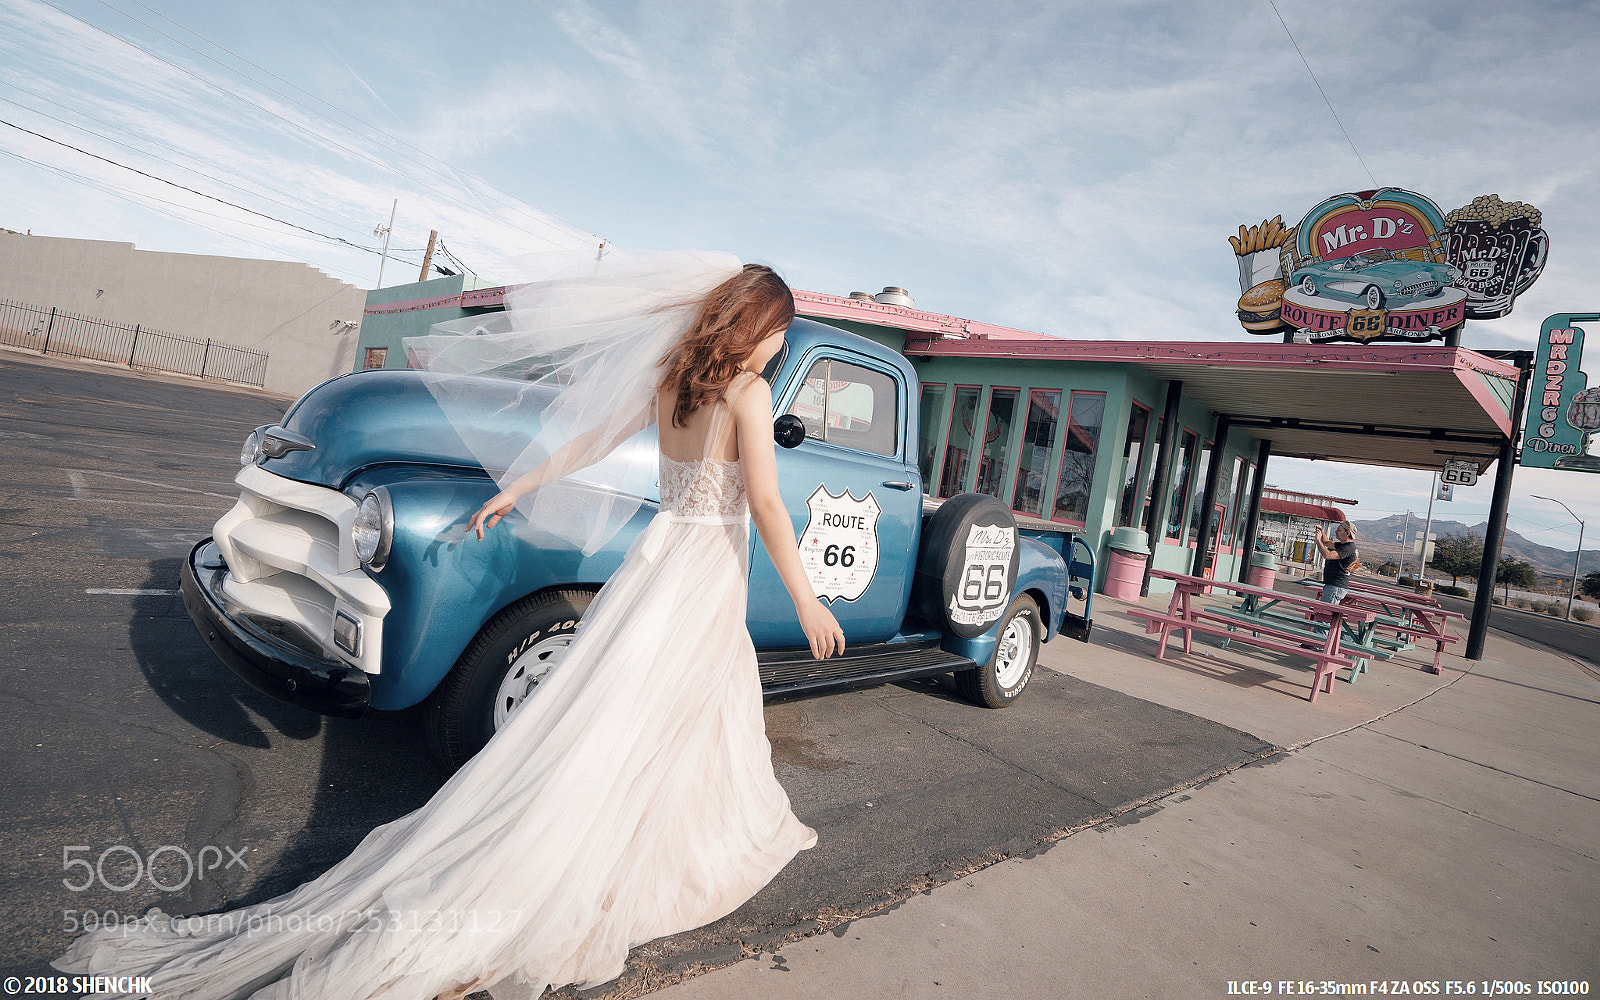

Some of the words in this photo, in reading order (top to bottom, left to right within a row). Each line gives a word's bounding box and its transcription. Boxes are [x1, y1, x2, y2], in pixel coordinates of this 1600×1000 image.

[1320, 224, 1368, 254] Mr.
[1371, 216, 1415, 239] D'z
[1461, 248, 1487, 261] Mr.
[1470, 268, 1489, 277] 66
[1479, 274, 1504, 290] BEER
[1283, 303, 1342, 330] ROUTE
[1352, 316, 1380, 331] 66
[1388, 307, 1458, 329] DINER
[1387, 327, 1426, 338] ARIZONA
[1526, 436, 1577, 455] Diner
[1446, 470, 1472, 482] 66
[823, 512, 865, 530] ROUTE
[824, 544, 856, 568] 66
[963, 564, 1005, 601] 66
[508, 630, 541, 665] H/P
